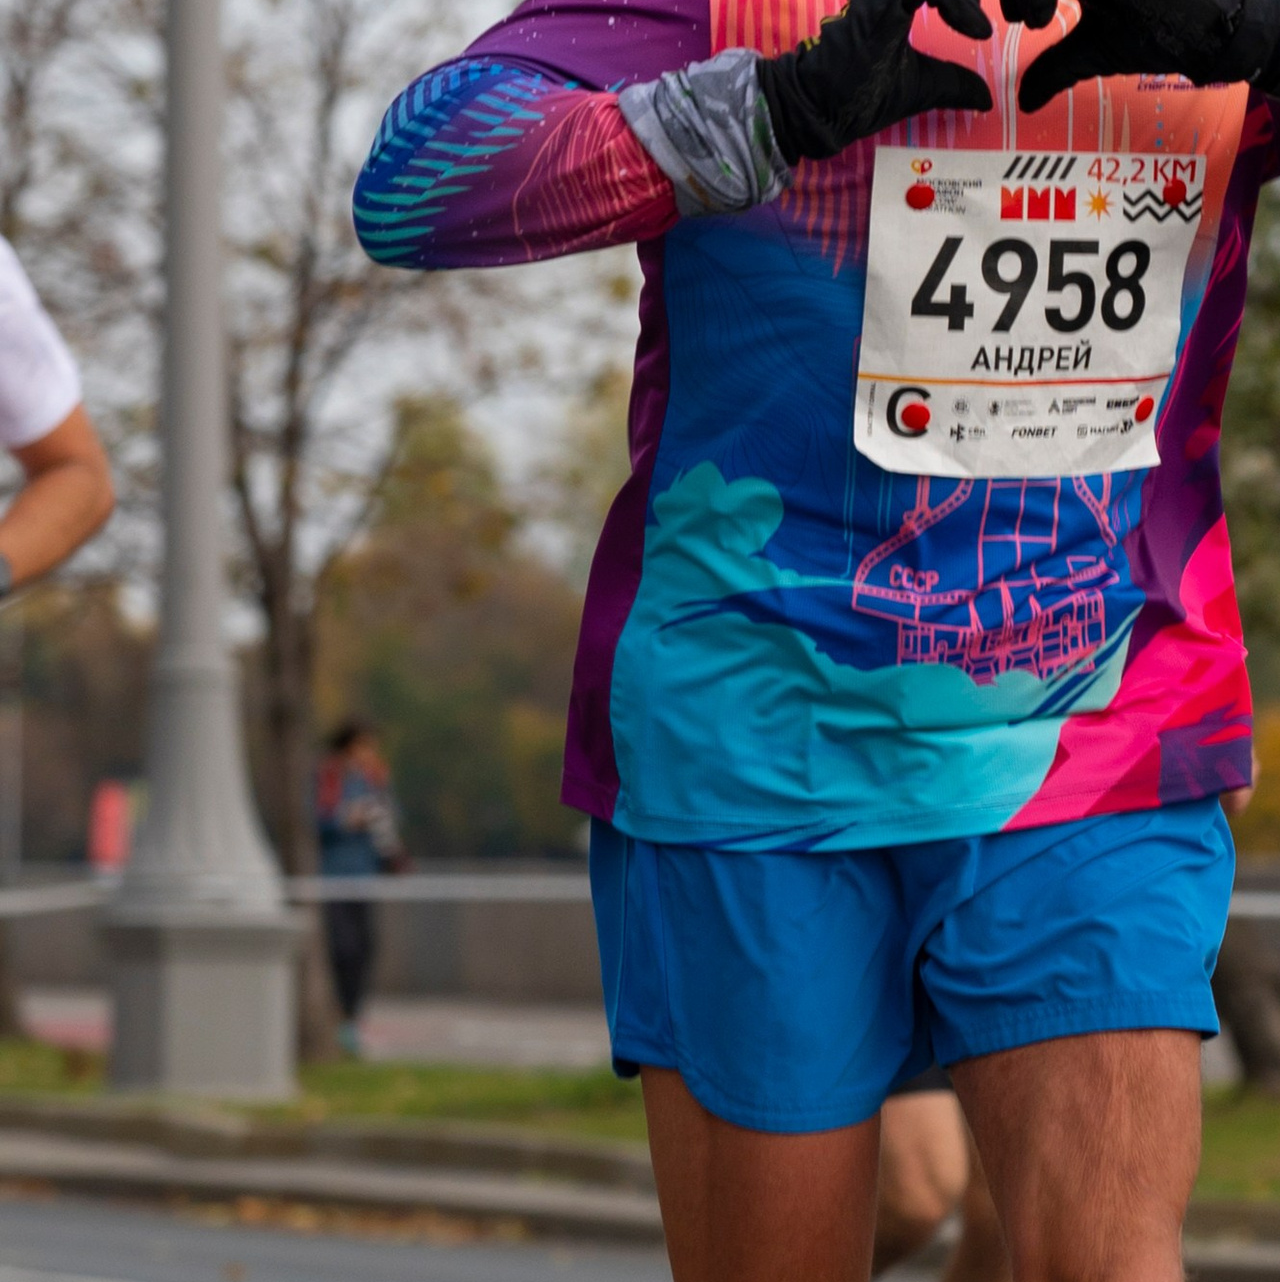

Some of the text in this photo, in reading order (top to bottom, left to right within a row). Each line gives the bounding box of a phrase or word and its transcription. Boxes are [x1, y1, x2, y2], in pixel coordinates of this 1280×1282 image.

[1087, 157, 1146, 185] 42,2
[911, 234, 1151, 334] 4958
[970, 338, 1093, 377] АНДРЕЙ
